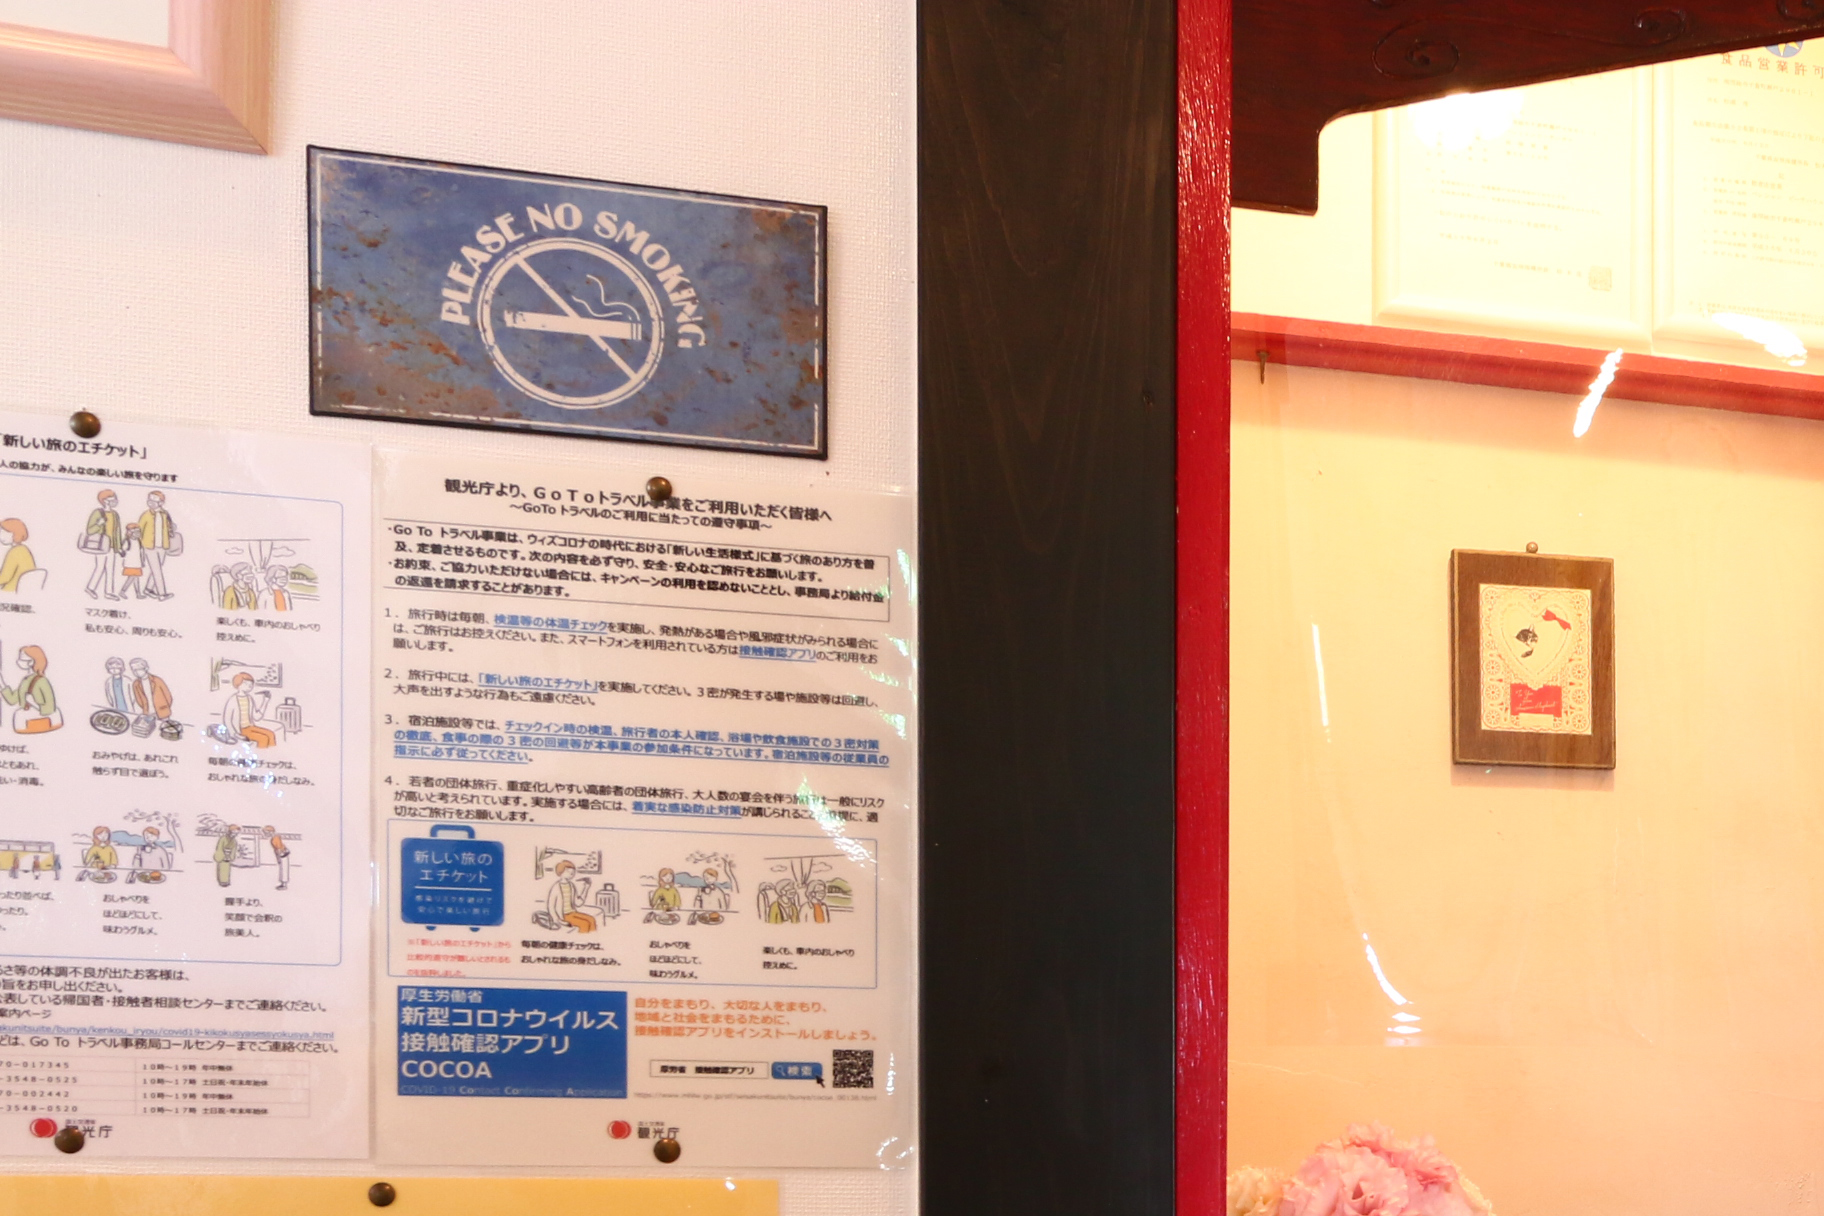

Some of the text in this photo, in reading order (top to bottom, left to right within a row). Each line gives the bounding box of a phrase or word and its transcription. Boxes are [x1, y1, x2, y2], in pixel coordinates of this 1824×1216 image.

[441, 202, 706, 349] PLEASE NO SMOKING
[0, 433, 148, 460] 新しい旅のエチケット」
[414, 850, 493, 866] 新しい旅の
[420, 869, 489, 884] エチケット
[0, 978, 123, 993] 旨をお申し出ください。
[401, 989, 484, 1004] 厚生労働省
[401, 1006, 620, 1031] 新型コロナウイルス
[401, 1031, 571, 1056] 接触確認アプリ
[401, 1059, 493, 1079] COCOA
